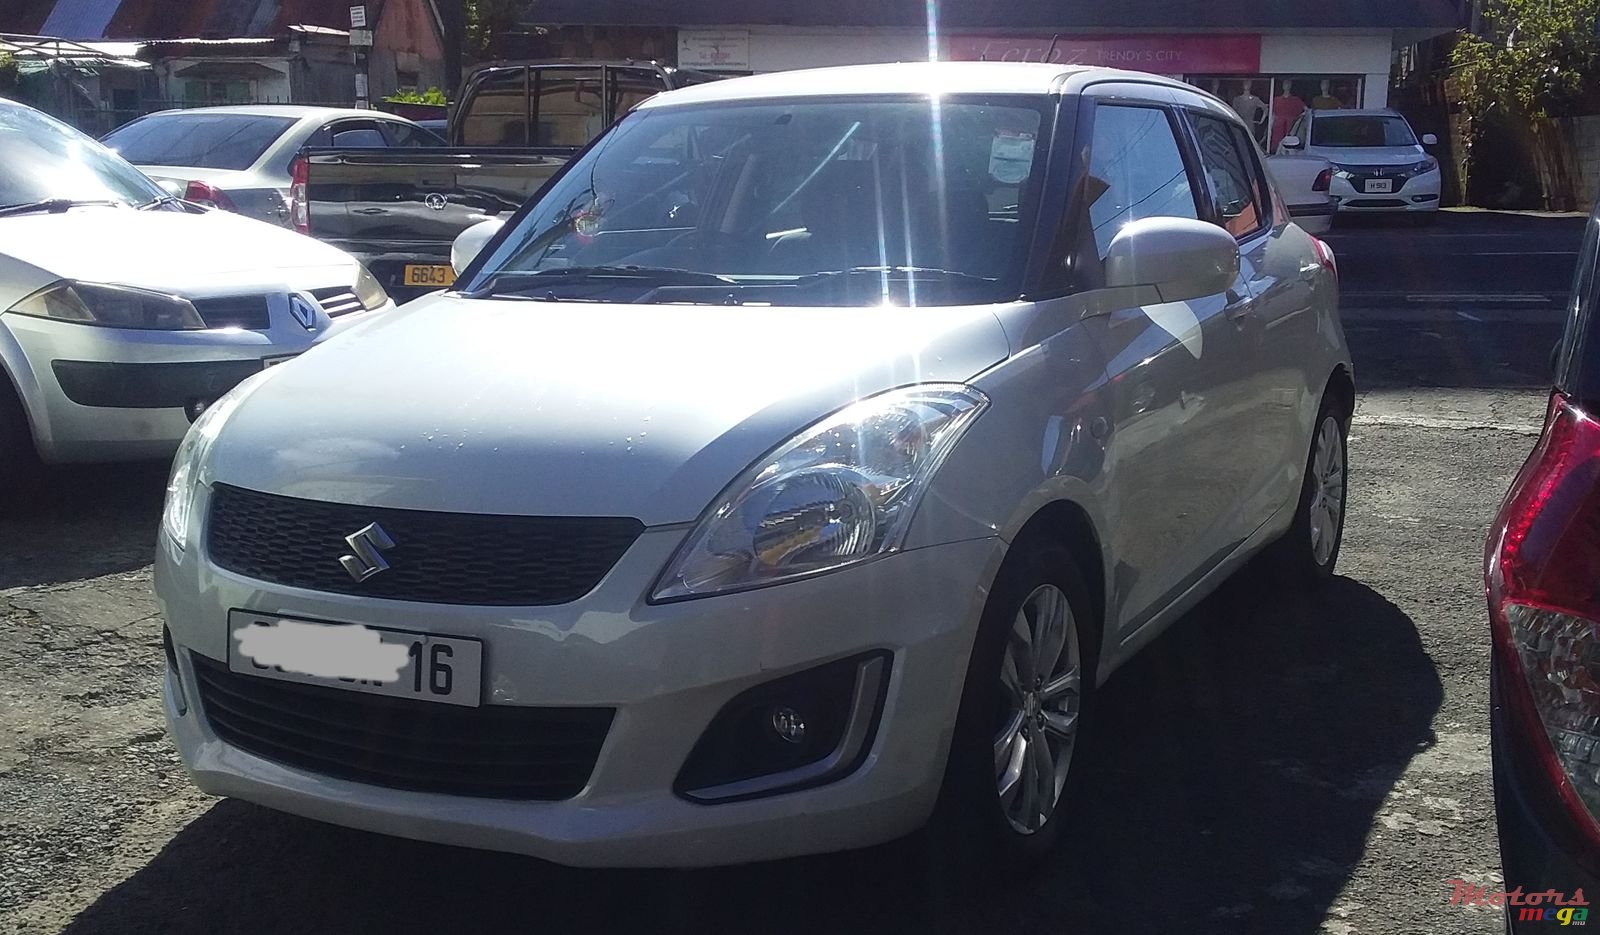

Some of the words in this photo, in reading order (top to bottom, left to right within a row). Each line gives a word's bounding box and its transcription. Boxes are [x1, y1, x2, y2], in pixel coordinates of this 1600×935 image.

[1155, 50, 1184, 61] CITY
[411, 267, 446, 283] 6643
[408, 640, 453, 695] 16
